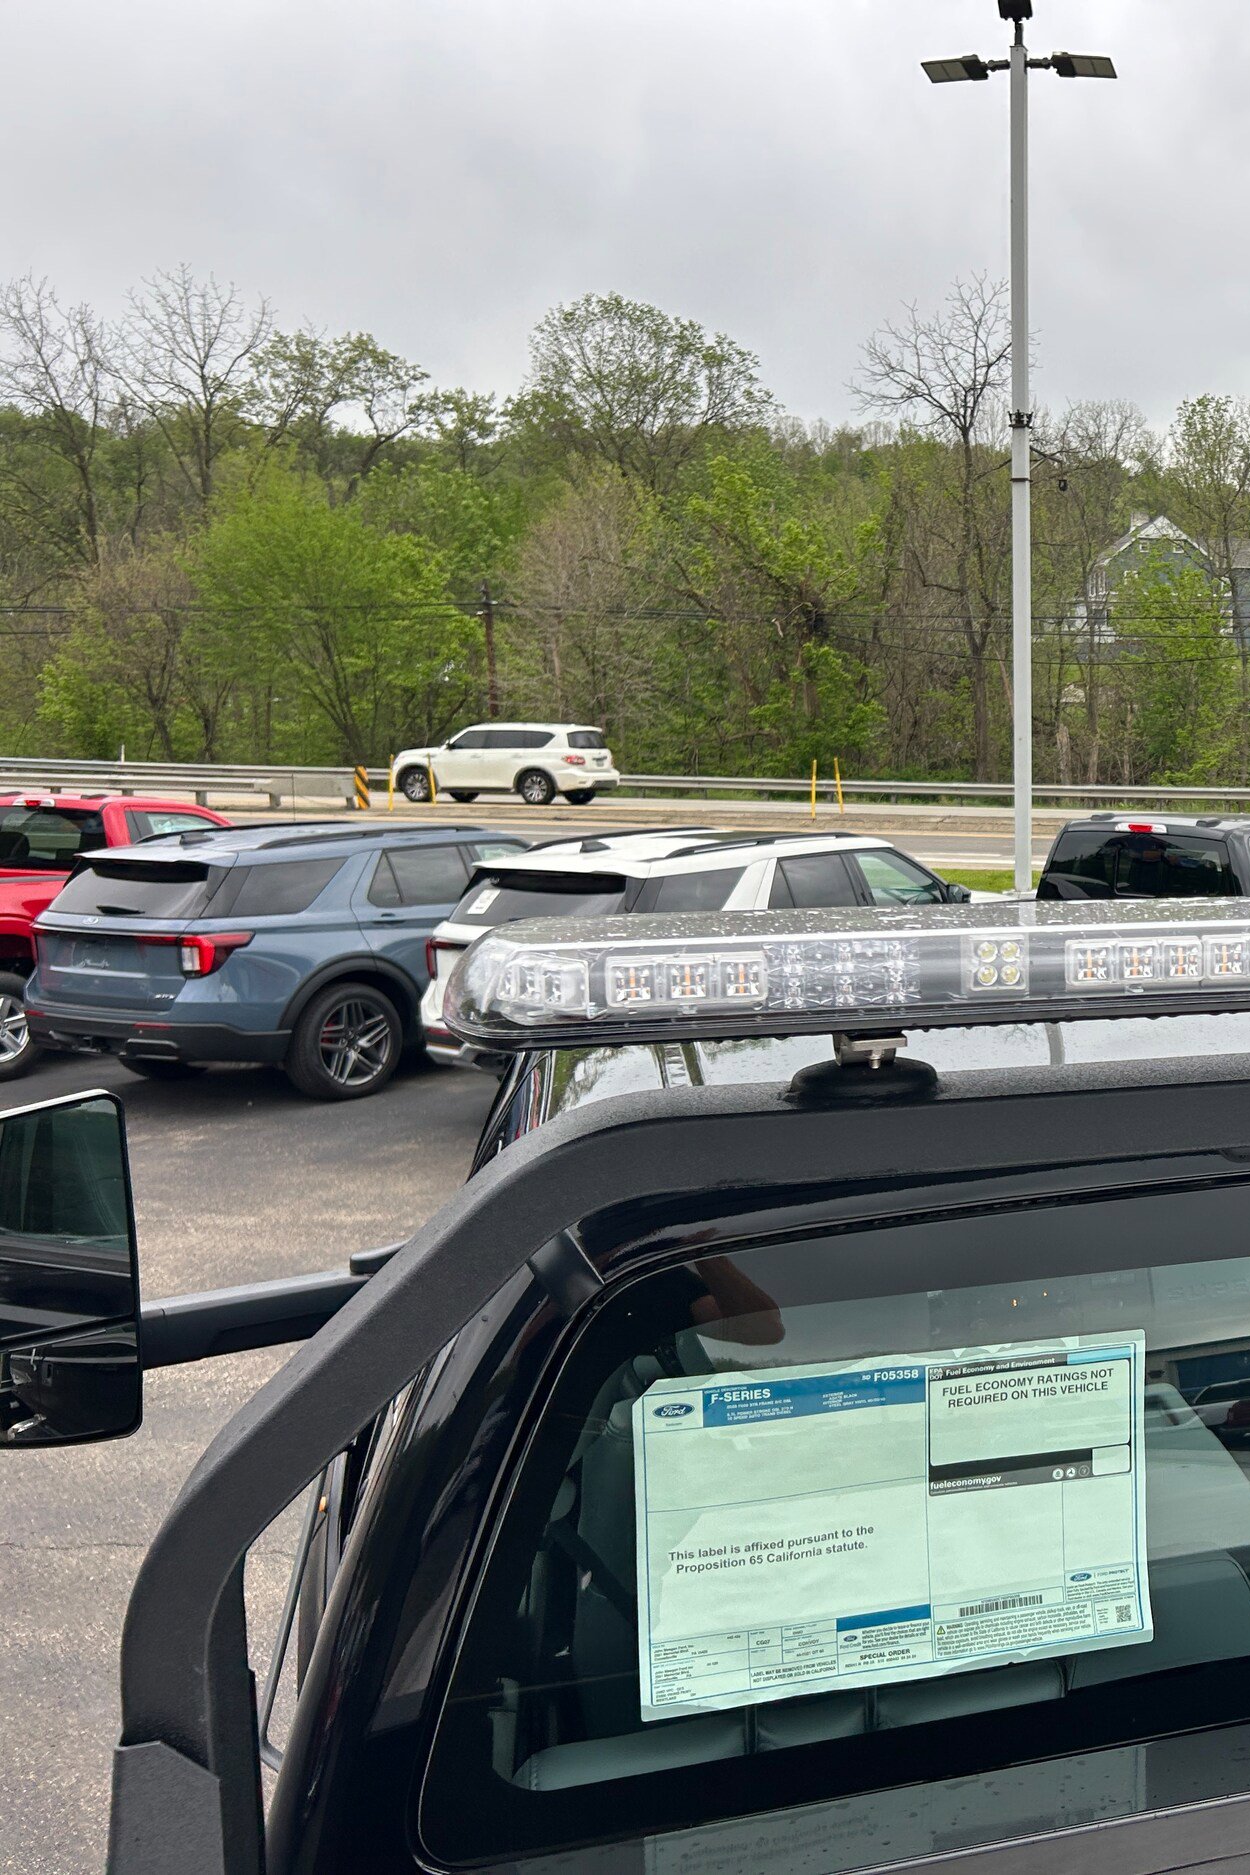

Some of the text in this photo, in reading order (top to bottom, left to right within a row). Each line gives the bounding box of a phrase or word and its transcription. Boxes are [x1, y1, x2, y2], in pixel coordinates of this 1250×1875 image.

[874, 1369, 919, 1382] F05358
[945, 1367, 961, 1377] Fuel
[962, 1364, 995, 1375] Economy
[996, 1361, 1009, 1370] and
[1011, 1357, 1055, 1368] Environment
[942, 1368, 1114, 1397] FUEL ECONOMY RATINGS NOT
[711, 1388, 771, 1403] F-SERIES
[948, 1380, 1108, 1409] REQUIRED ON THIS VEHICLE
[930, 1475, 1001, 1490] fueleconomy.gov
[668, 1525, 874, 1562] This label is affixed pursuant to the
[676, 1541, 868, 1574] Proposition 65 California statute.
[860, 1648, 911, 1660] SPECIAL ORDER
